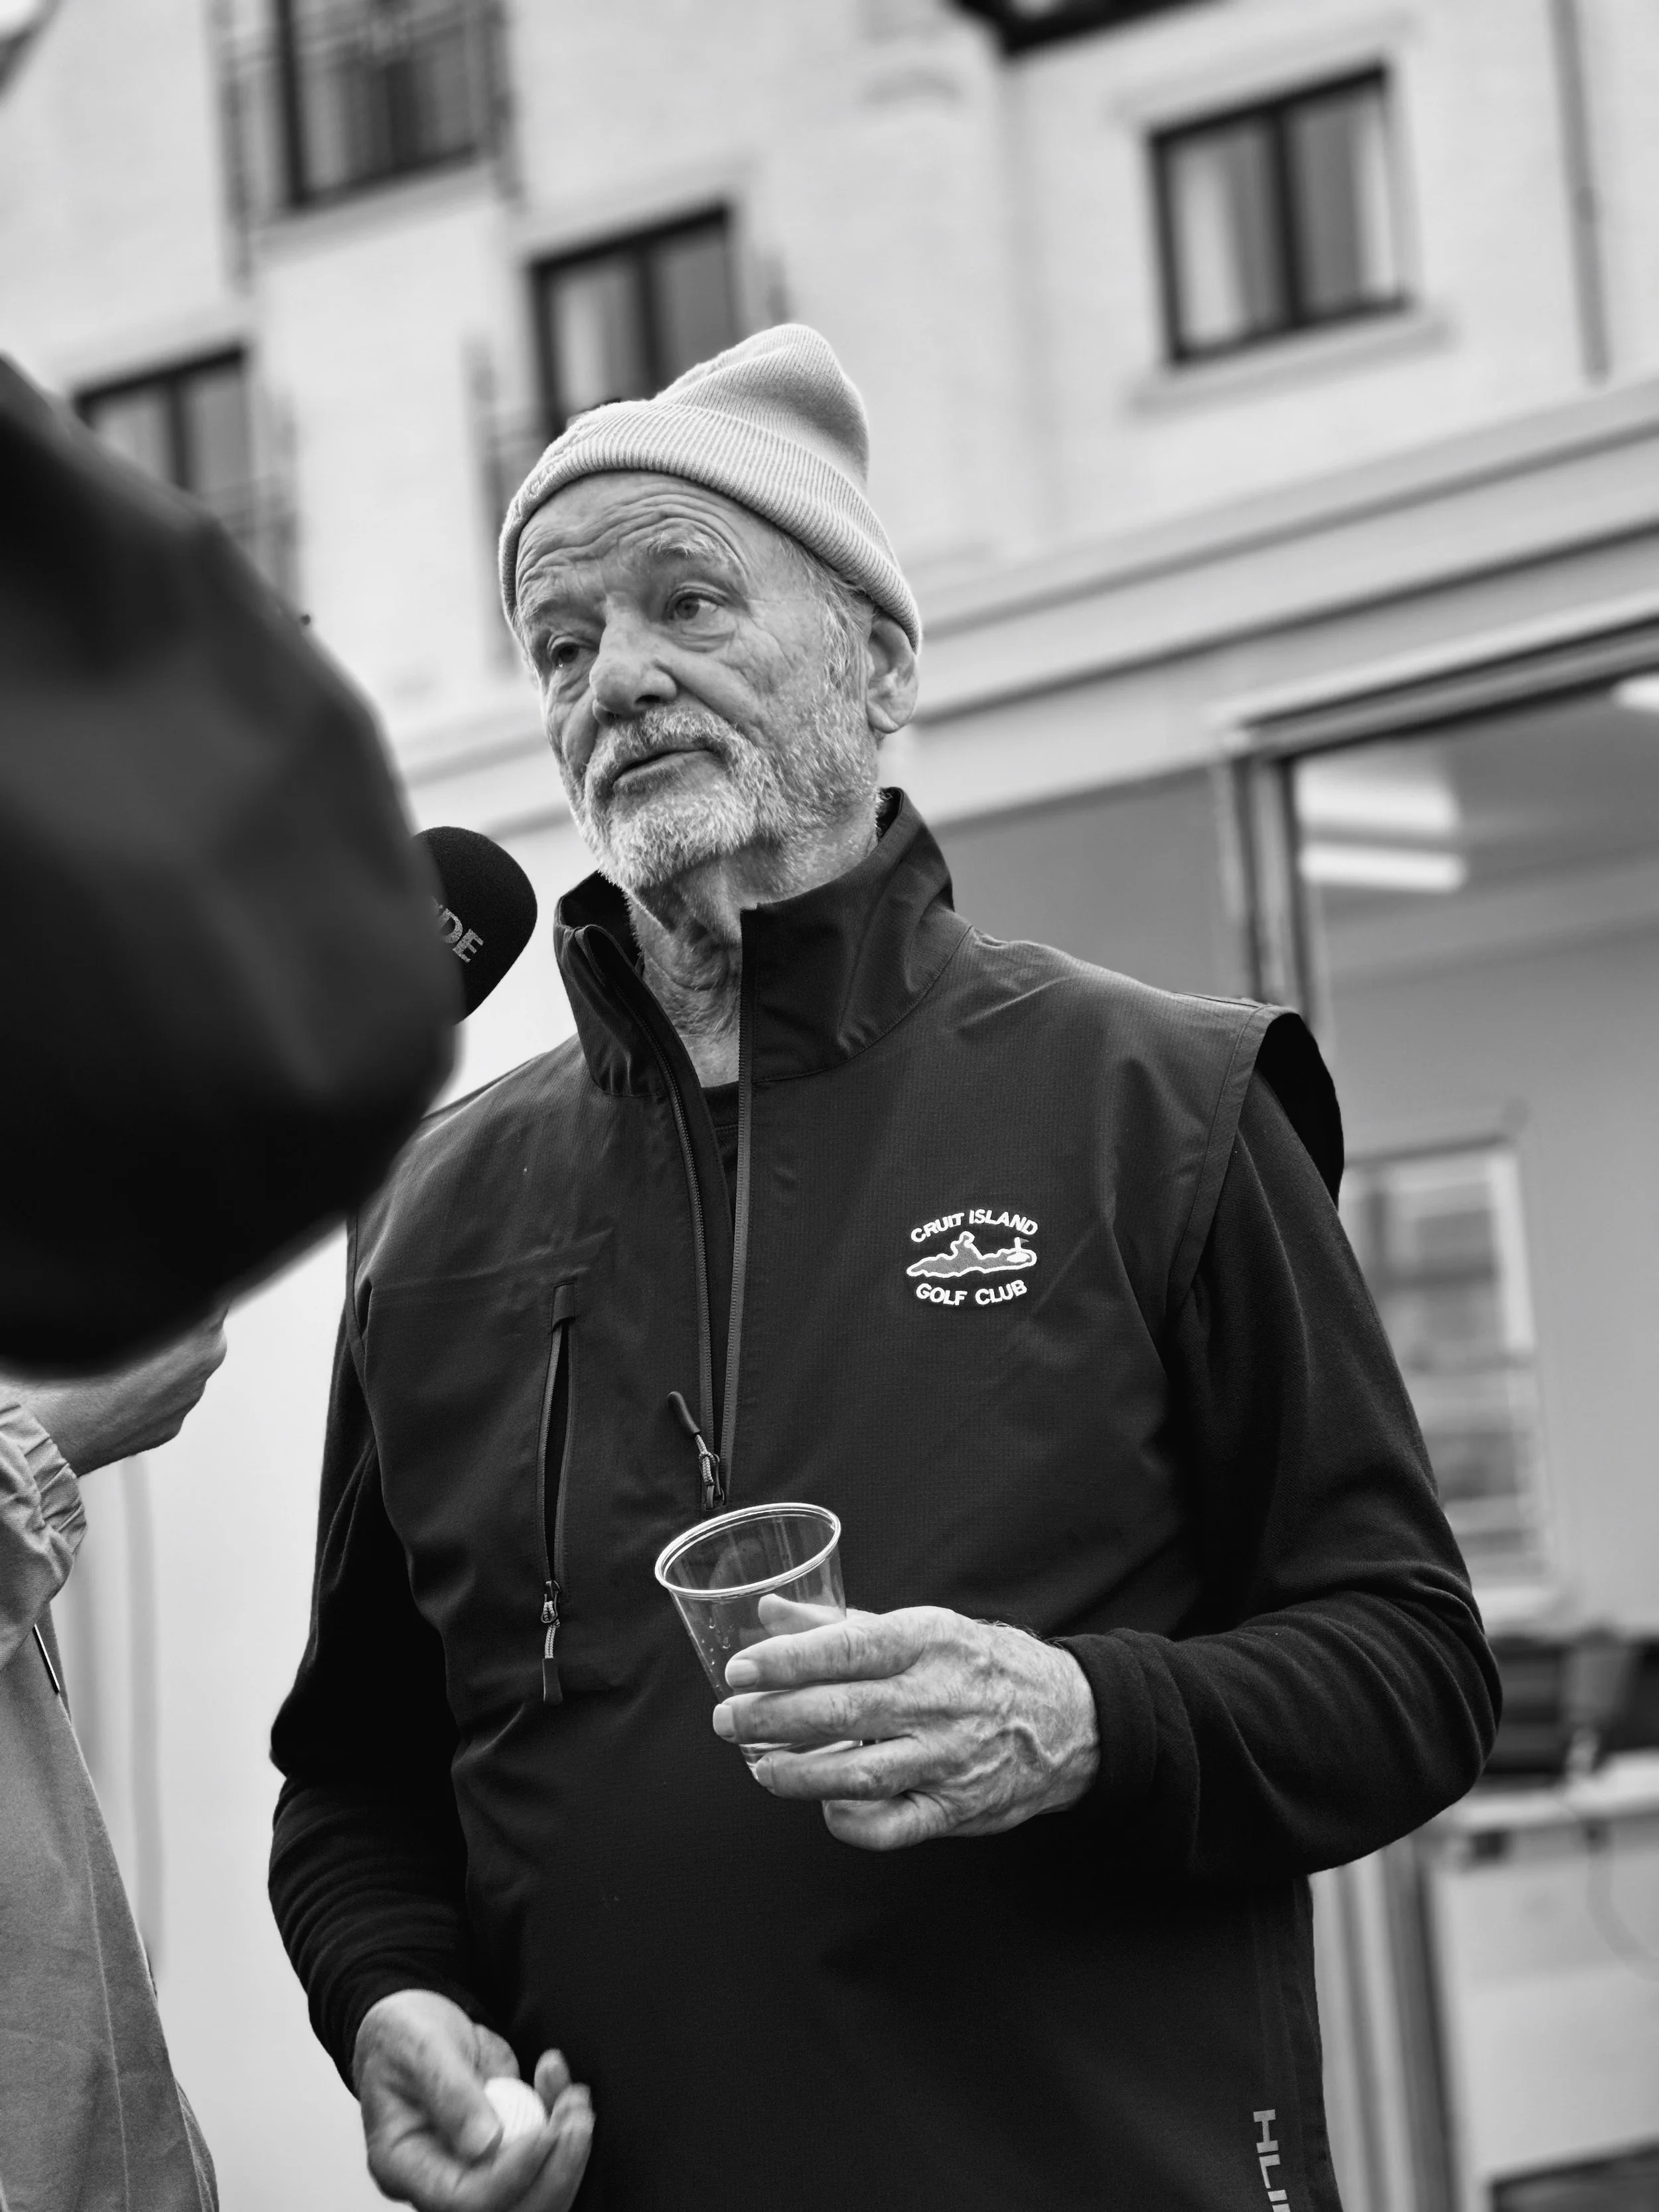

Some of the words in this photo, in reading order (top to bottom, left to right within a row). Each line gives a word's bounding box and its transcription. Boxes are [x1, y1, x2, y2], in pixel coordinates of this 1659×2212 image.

[434, 901, 484, 962] DE
[910, 1213, 965, 1242] CRUIT
[969, 1209, 1039, 1235] ISLAND
[916, 1283, 968, 1305] GOLF
[975, 1280, 1027, 1305] CLUB
[1253, 2109, 1291, 2212] HLI
